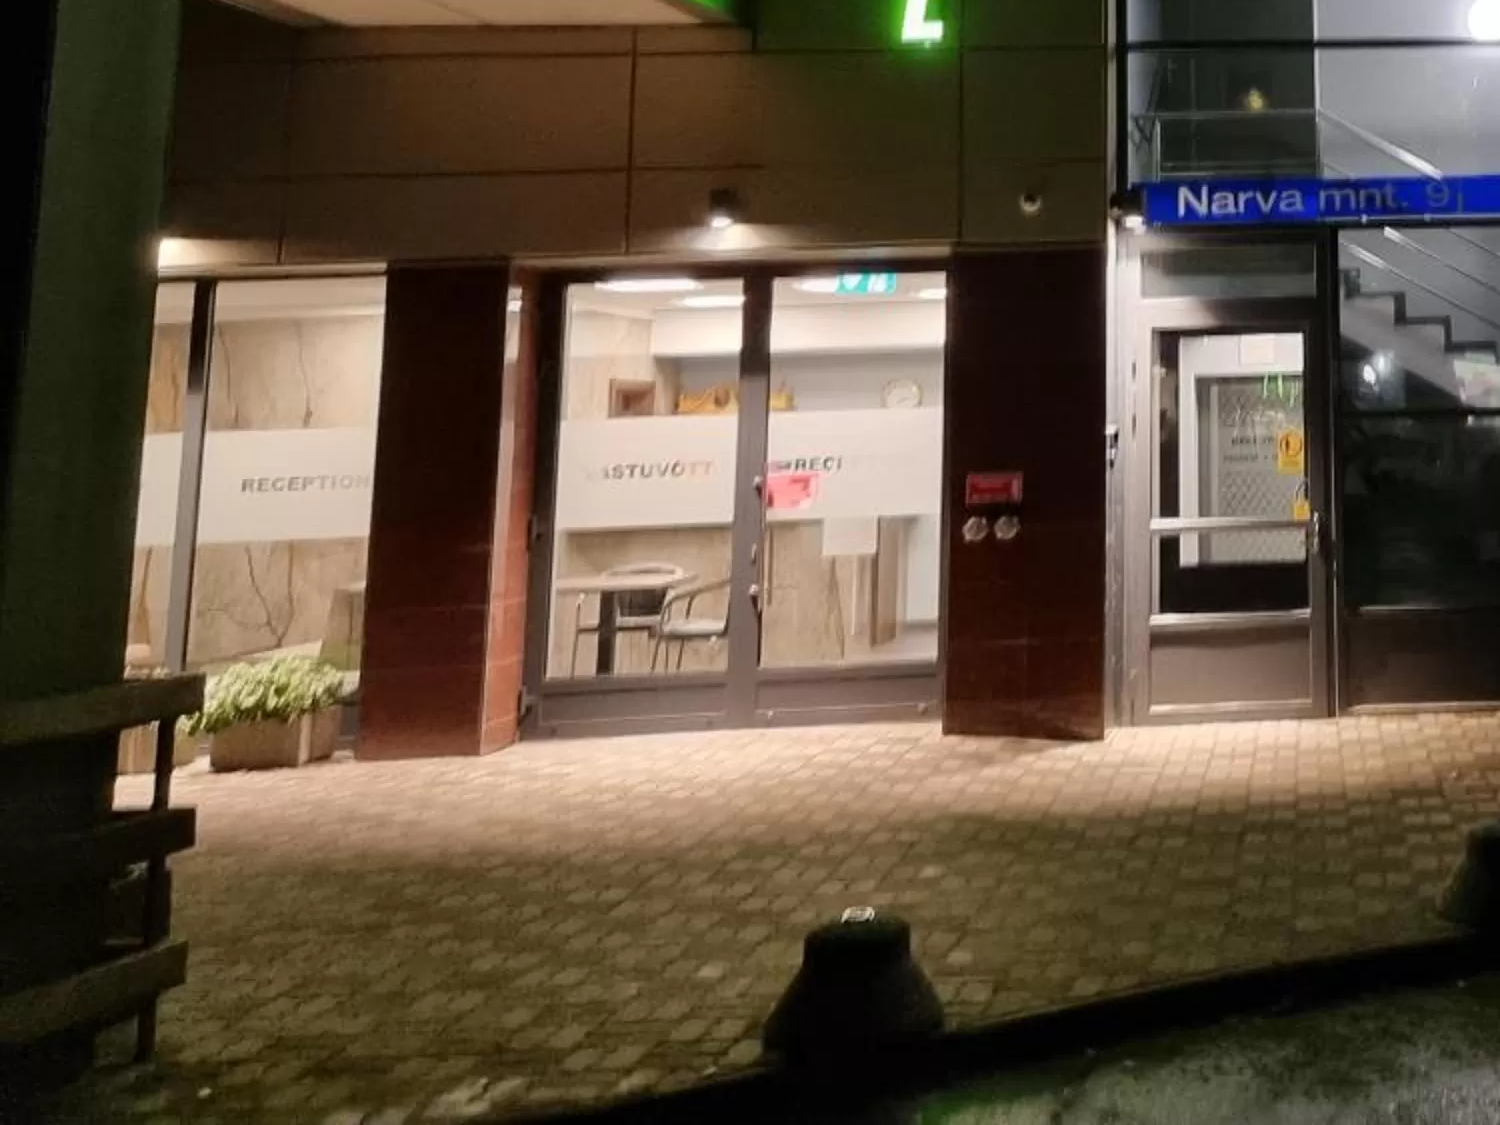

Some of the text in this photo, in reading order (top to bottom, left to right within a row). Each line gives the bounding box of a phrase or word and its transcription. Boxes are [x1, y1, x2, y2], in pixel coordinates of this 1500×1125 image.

[1177, 184, 1305, 218] Narva
[1319, 182, 1408, 212] mnt.
[240, 475, 371, 494] RECEPTION
